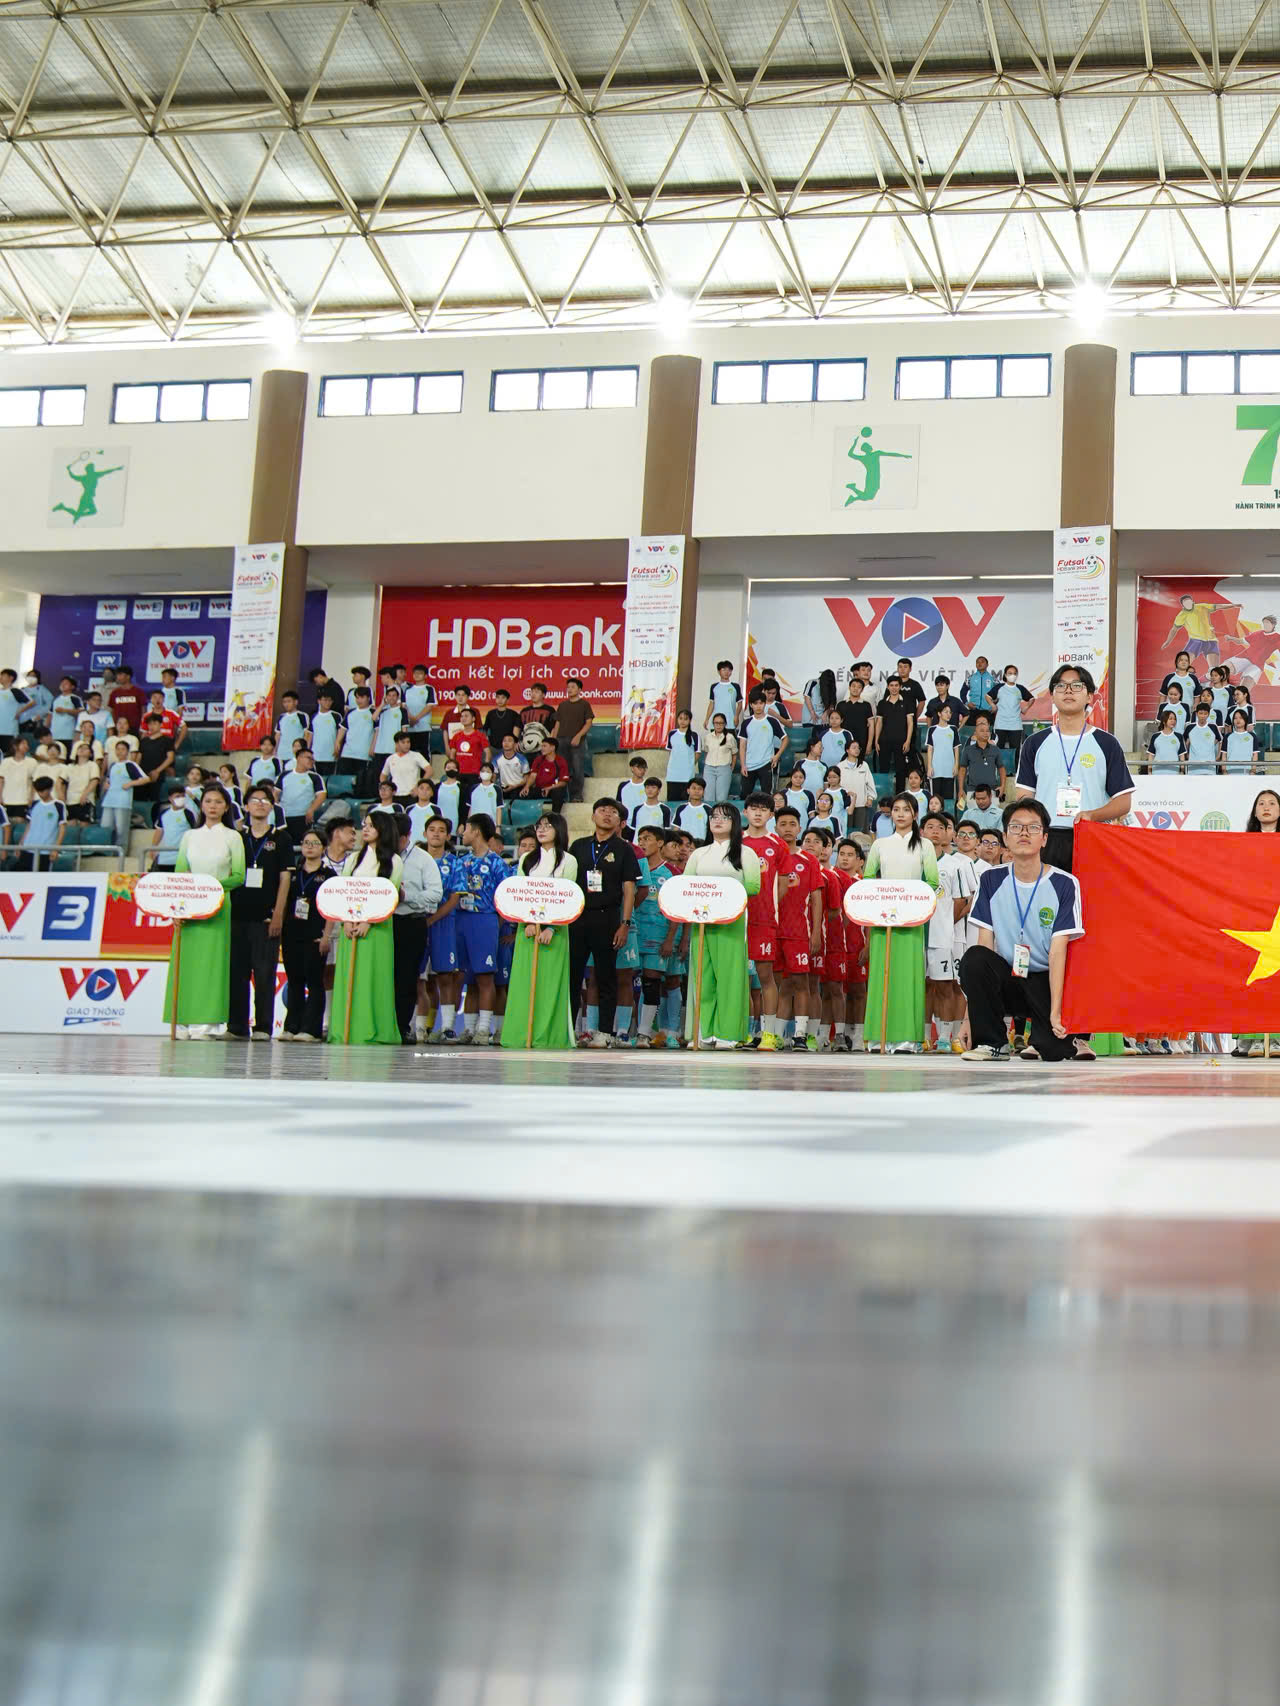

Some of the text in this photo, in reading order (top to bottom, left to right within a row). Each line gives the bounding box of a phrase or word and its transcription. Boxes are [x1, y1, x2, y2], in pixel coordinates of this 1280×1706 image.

[824, 596, 1005, 658] VOV
[428, 617, 622, 658] HDBank
[157, 641, 207, 659] VOV
[97, 656, 116, 664] VOV
[1058, 653, 1093, 662] HDBank
[232, 664, 263, 673] HDBank
[428, 664, 590, 680] Cam kết lợi ích cao
[1134, 810, 1190, 829] VOV
[50, 895, 90, 930] 3
[624, 949, 636, 960] 14
[760, 943, 771, 955] 14
[485, 955, 493, 966] 4
[796, 953, 808, 965] 13
[941, 961, 948, 972] 7
[59, 967, 150, 1001] VOV
[66, 1006, 125, 1016] GIAO THÔNG
